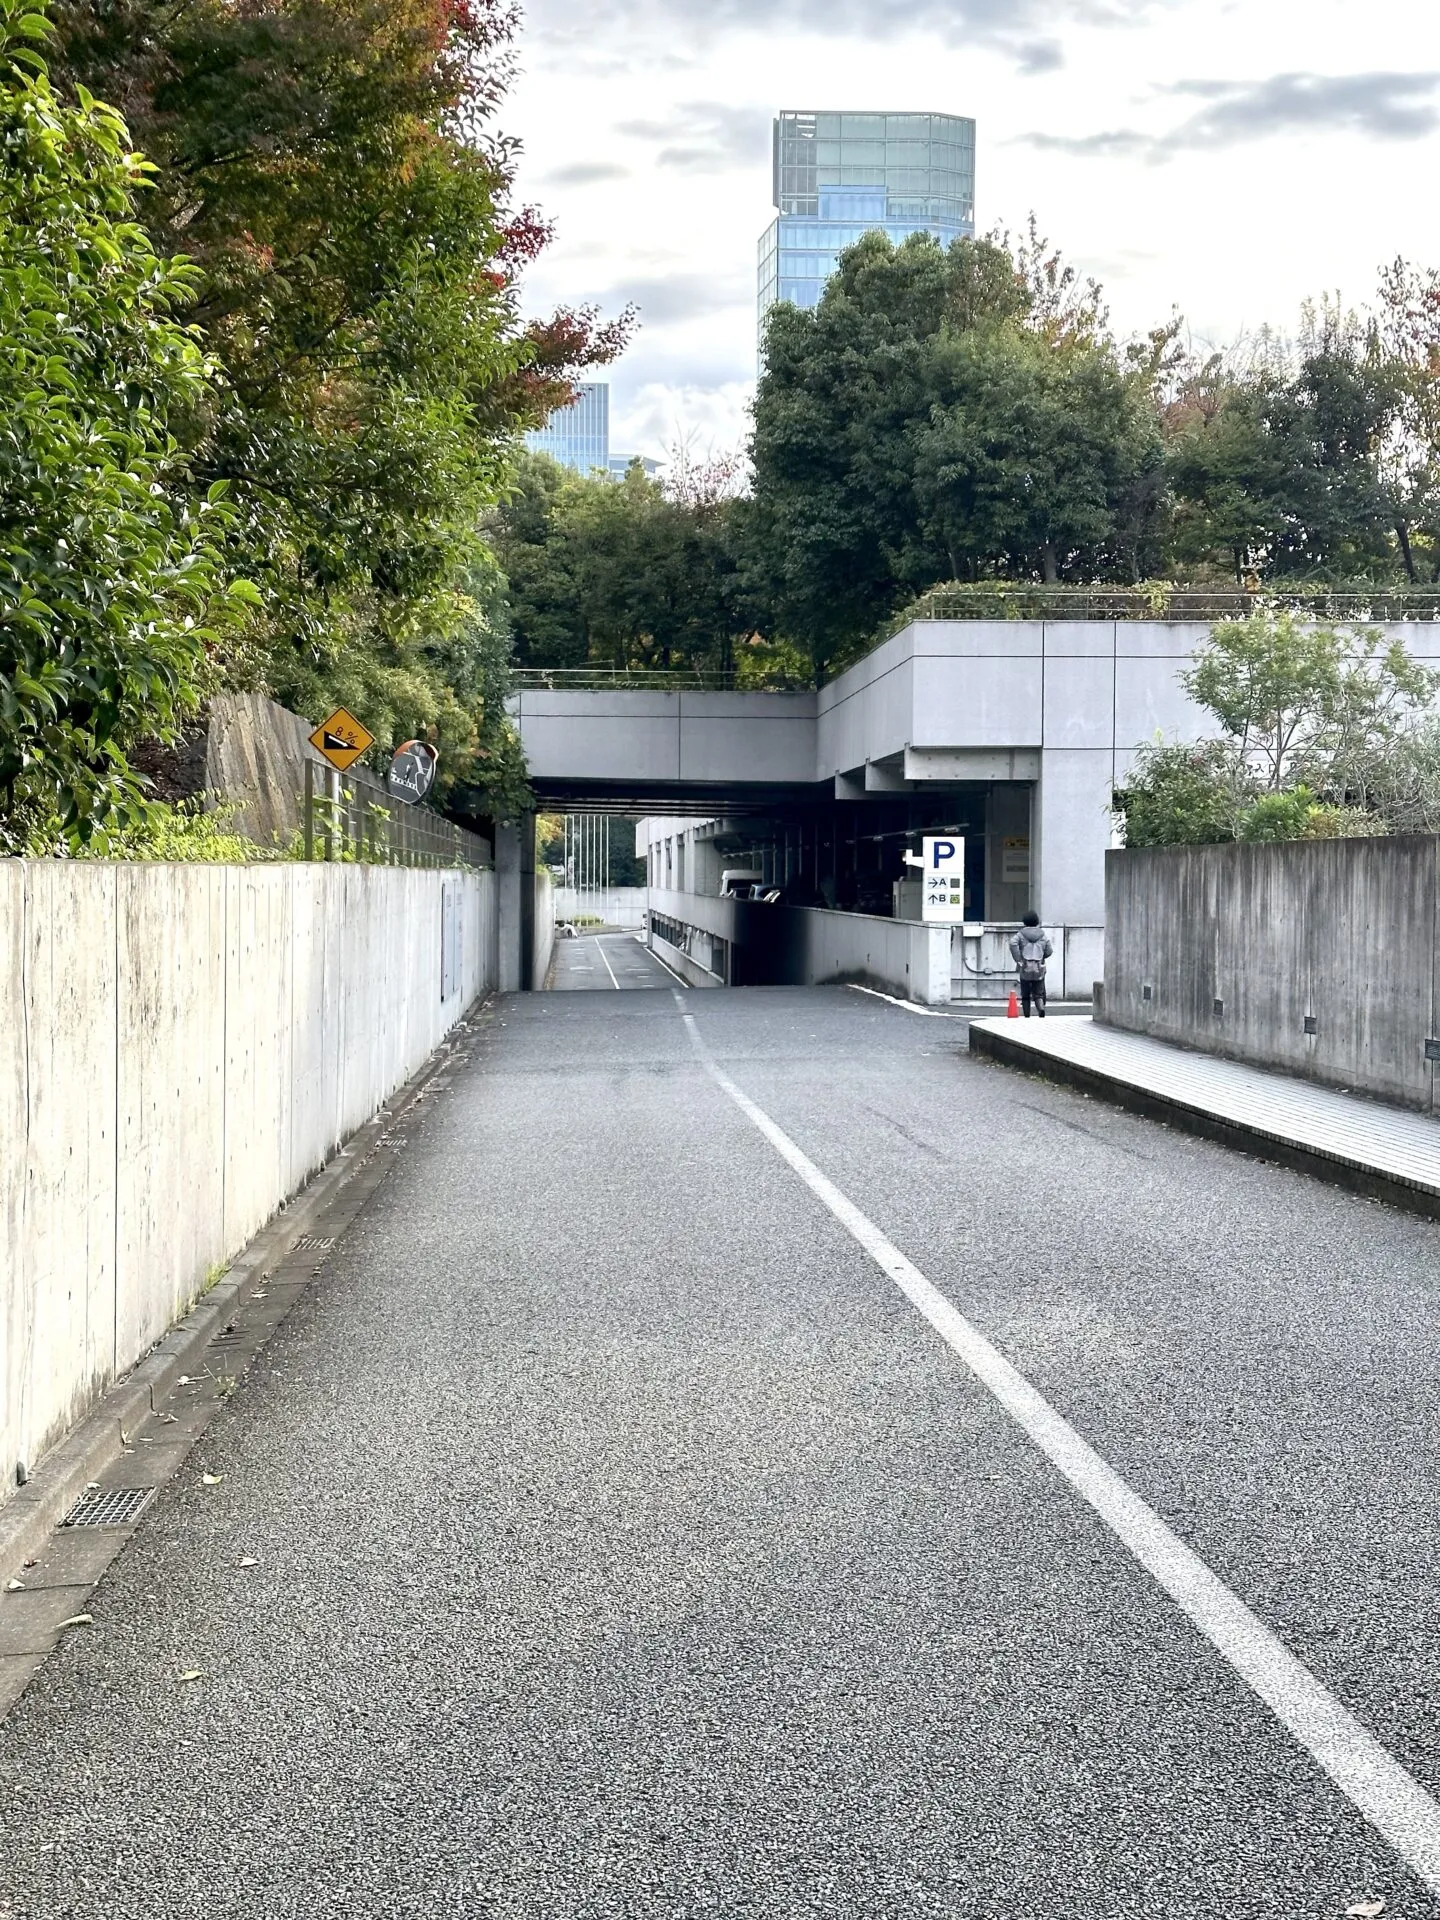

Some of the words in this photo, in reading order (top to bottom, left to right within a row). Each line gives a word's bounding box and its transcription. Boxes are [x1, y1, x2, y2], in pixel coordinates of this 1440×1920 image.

[933, 841, 955, 869] P
[939, 878, 947, 886] A
[939, 894, 946, 902] B
